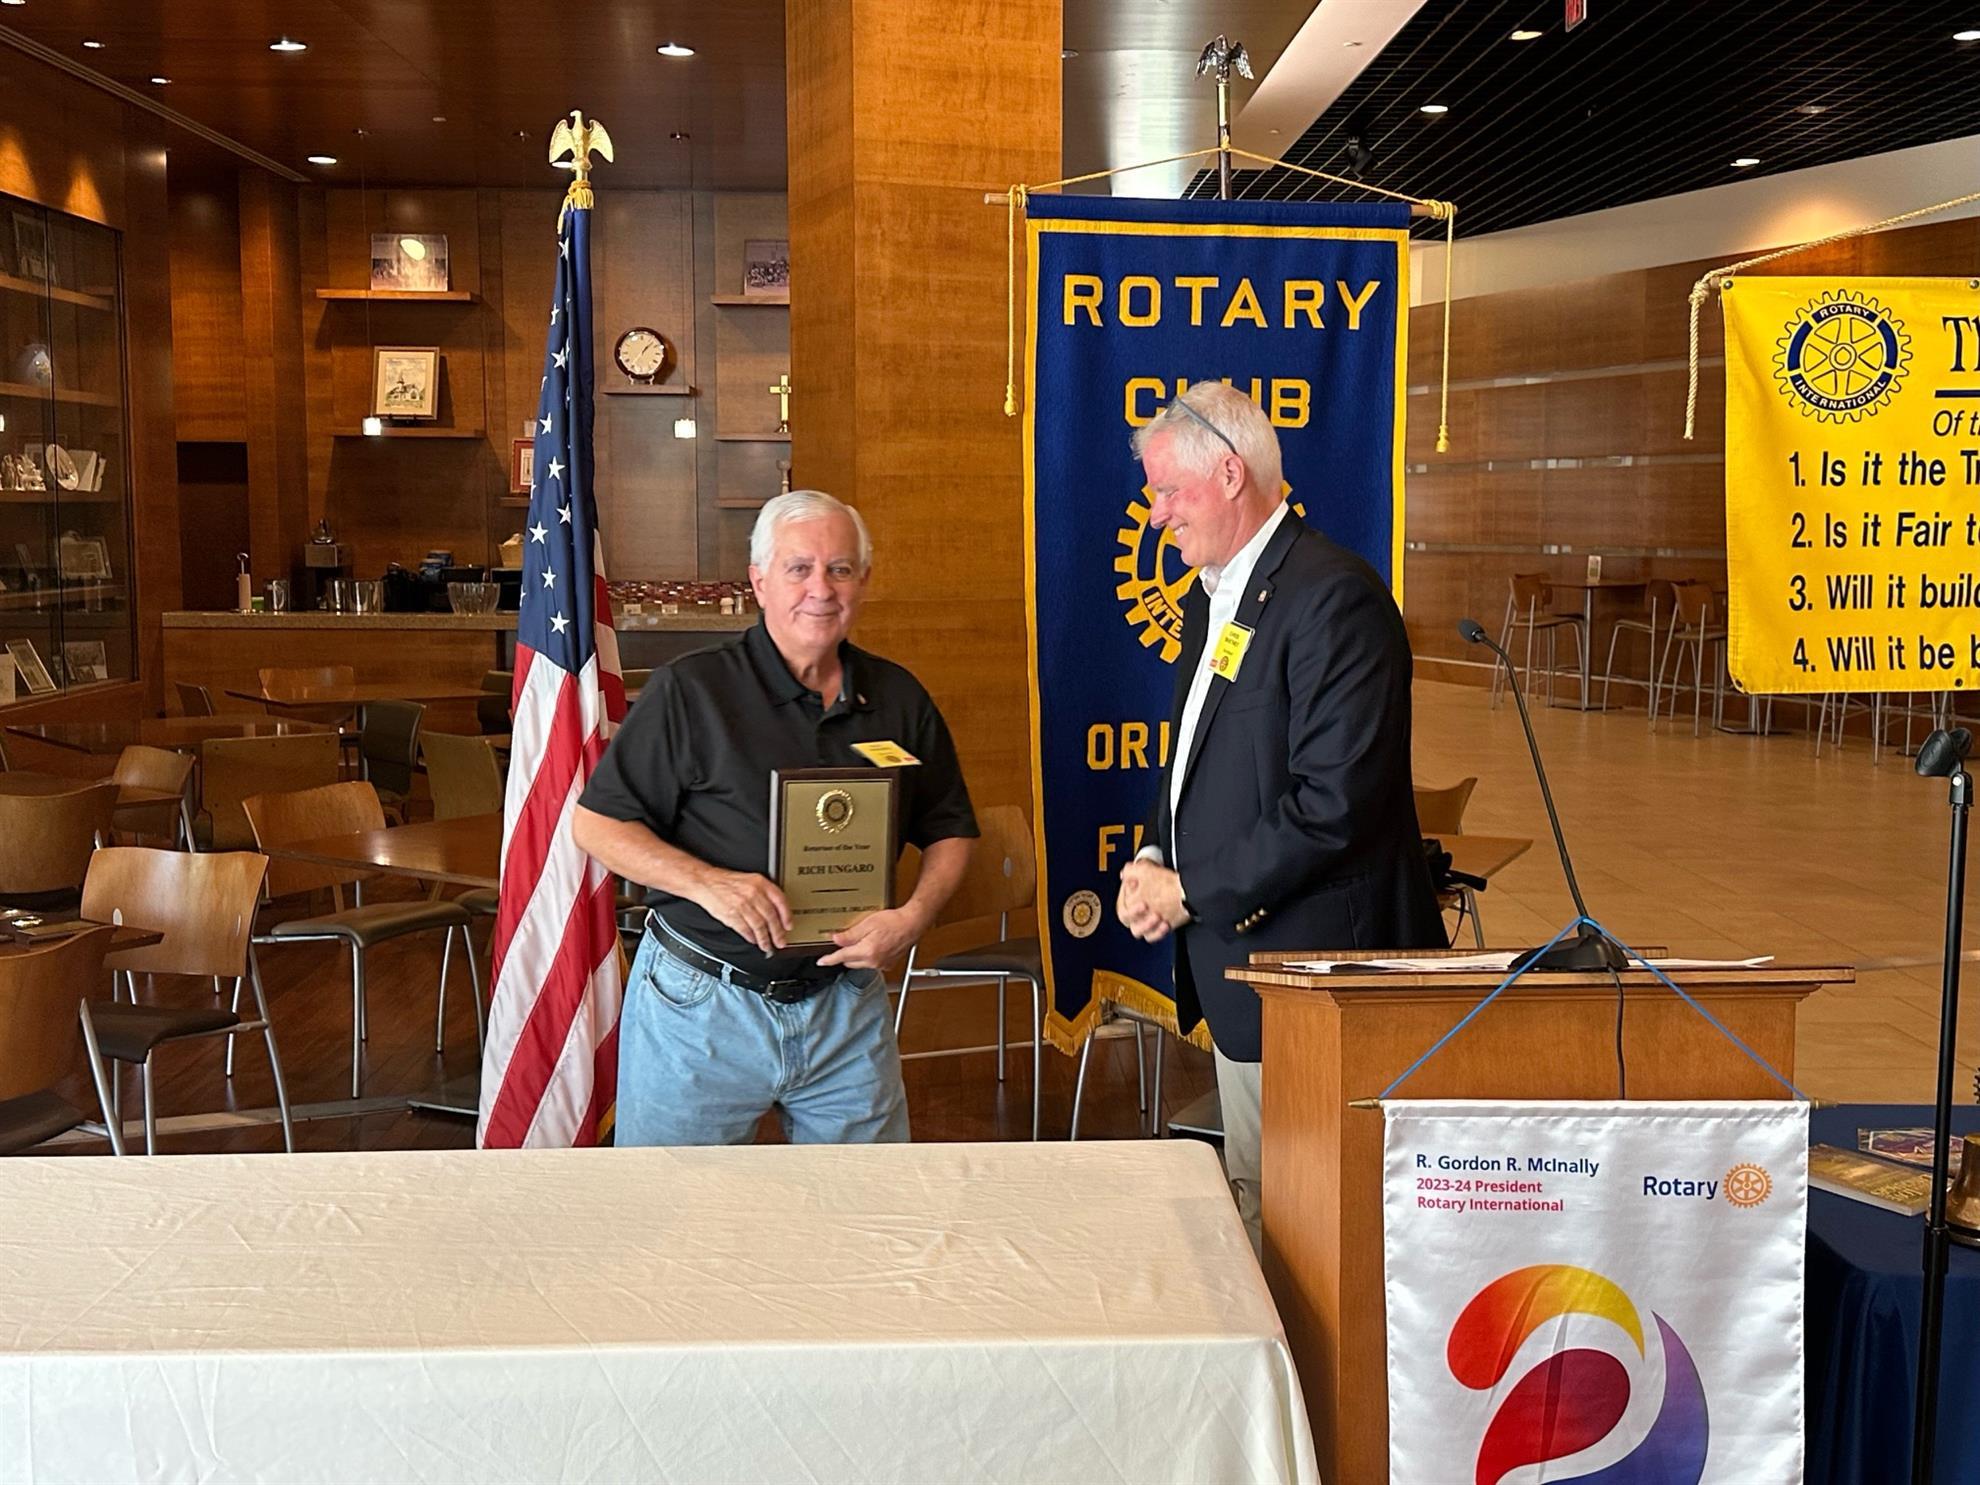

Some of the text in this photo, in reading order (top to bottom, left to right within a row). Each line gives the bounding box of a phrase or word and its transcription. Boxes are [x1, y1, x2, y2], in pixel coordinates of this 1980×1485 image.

[1063, 273, 1381, 330] ROTARY
[1819, 304, 1871, 319] ROTARY
[1795, 379, 1887, 409] INTERNATIONAL
[1933, 410, 1965, 437] Of
[1788, 451, 1806, 487] 1.
[1821, 451, 1846, 486] Is
[1862, 451, 1883, 486] it
[1898, 450, 1946, 487] the
[1791, 513, 1813, 549] 2.
[1825, 512, 1847, 548] Is
[1861, 512, 1881, 548] it
[1895, 511, 1952, 548] Fair
[1788, 575, 1813, 611] 3.
[1826, 574, 1873, 610] Will
[1887, 574, 1906, 609] it
[1793, 637, 1816, 673] 4.
[1827, 636, 1876, 672] Will
[1888, 636, 1906, 671] it
[1919, 635, 1955, 670] be
[797, 863, 874, 875] RICH UNGARO
[1416, 1154, 1600, 1177] R. Gordon R. McInally
[1416, 1178, 1543, 1193] 2023-24 President
[1643, 1175, 1719, 1200] Rotary
[1418, 1197, 1563, 1213] Rotary International
